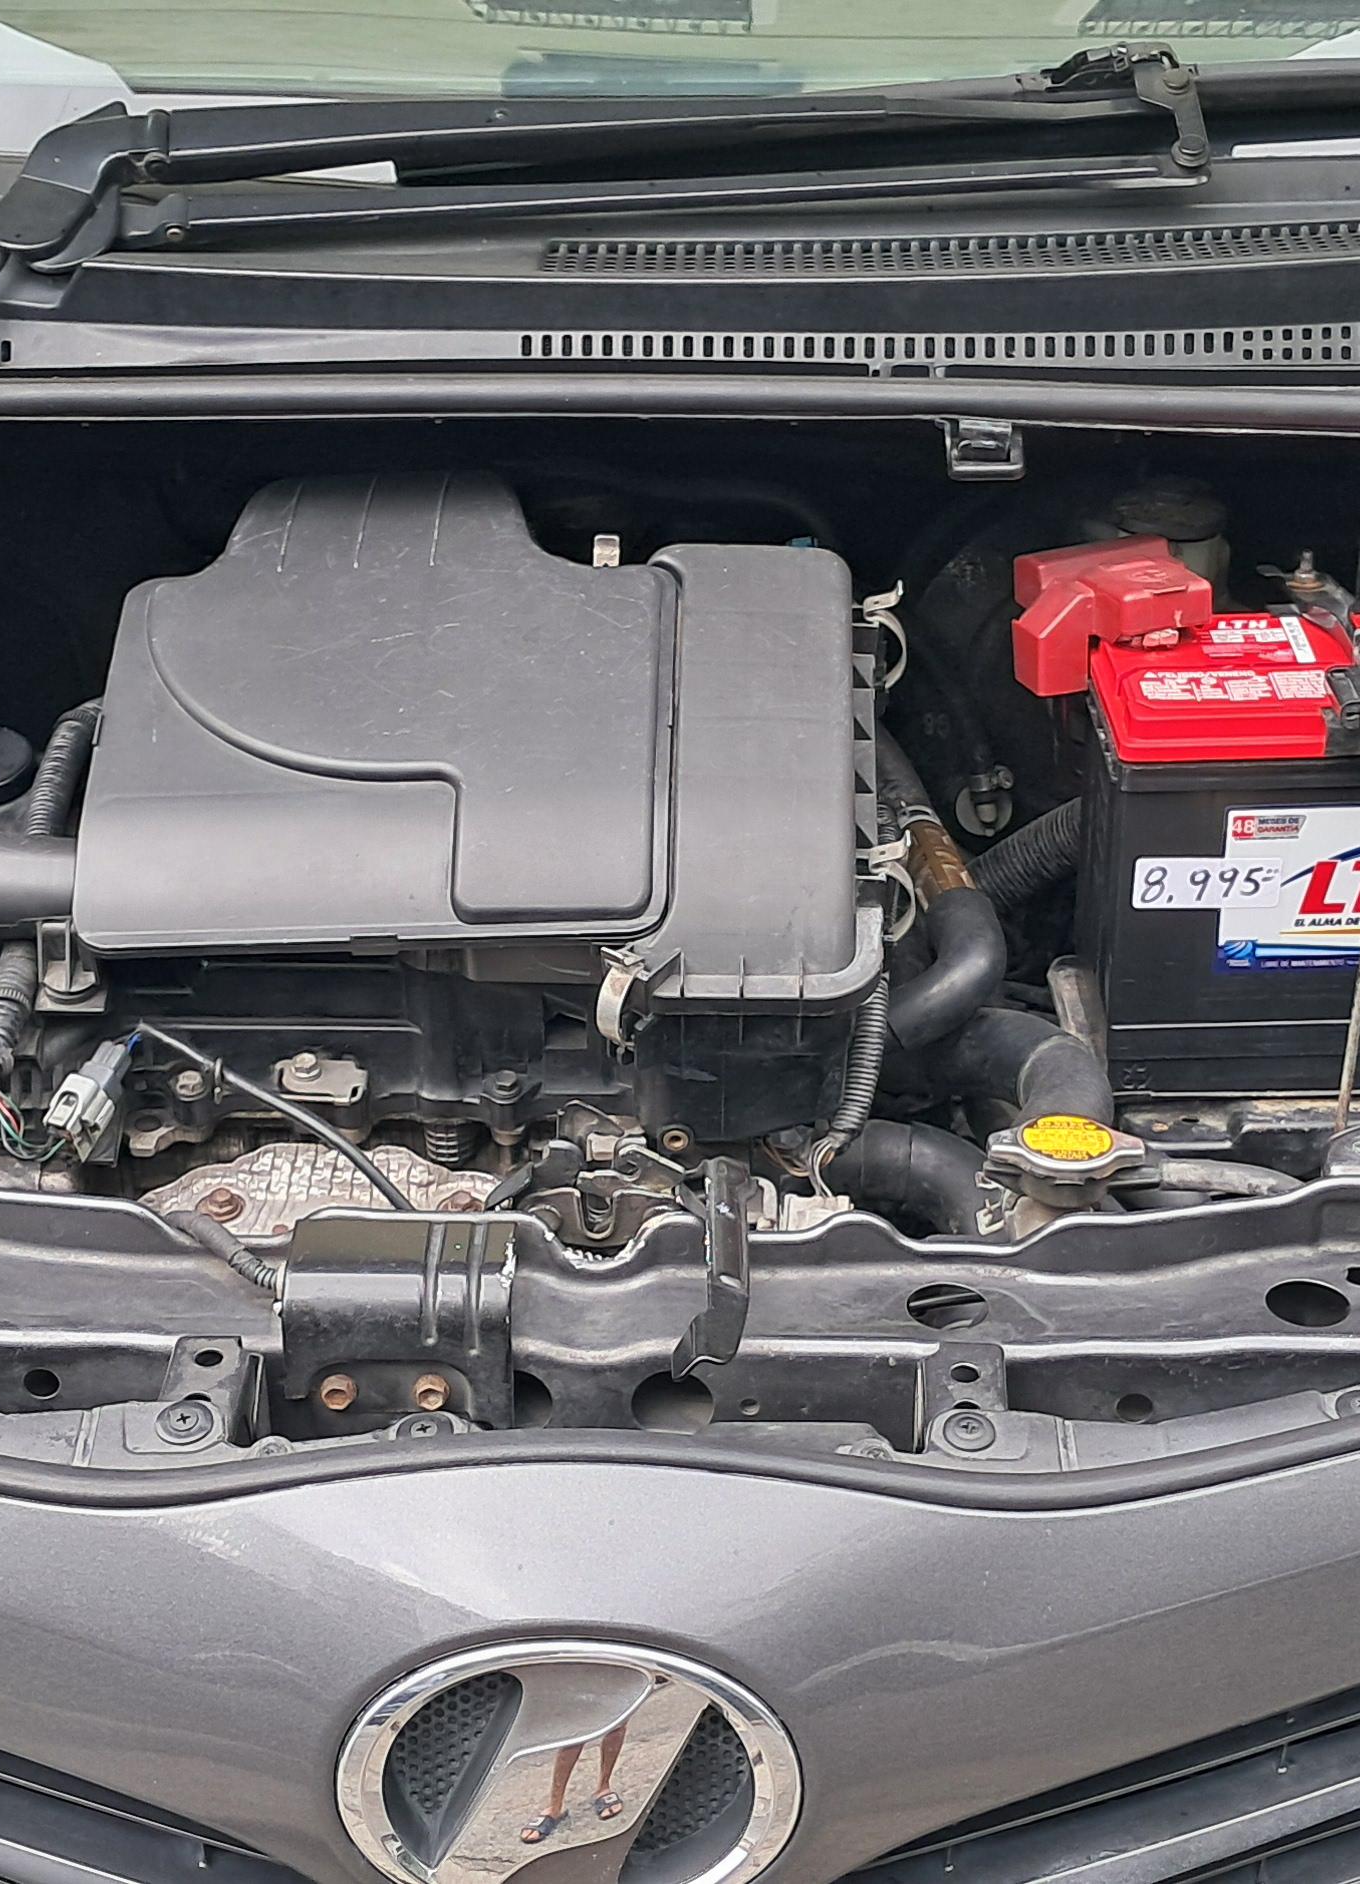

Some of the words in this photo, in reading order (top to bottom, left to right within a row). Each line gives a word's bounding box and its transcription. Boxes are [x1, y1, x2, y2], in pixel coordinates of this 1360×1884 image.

[1217, 618, 1269, 629] LTH
[1258, 817, 1287, 825] MESES
[1233, 819, 1255, 834] 48
[1294, 917, 1306, 927] EL
[1308, 917, 1342, 927] ALMA
[1345, 917, 1360, 926] DE
